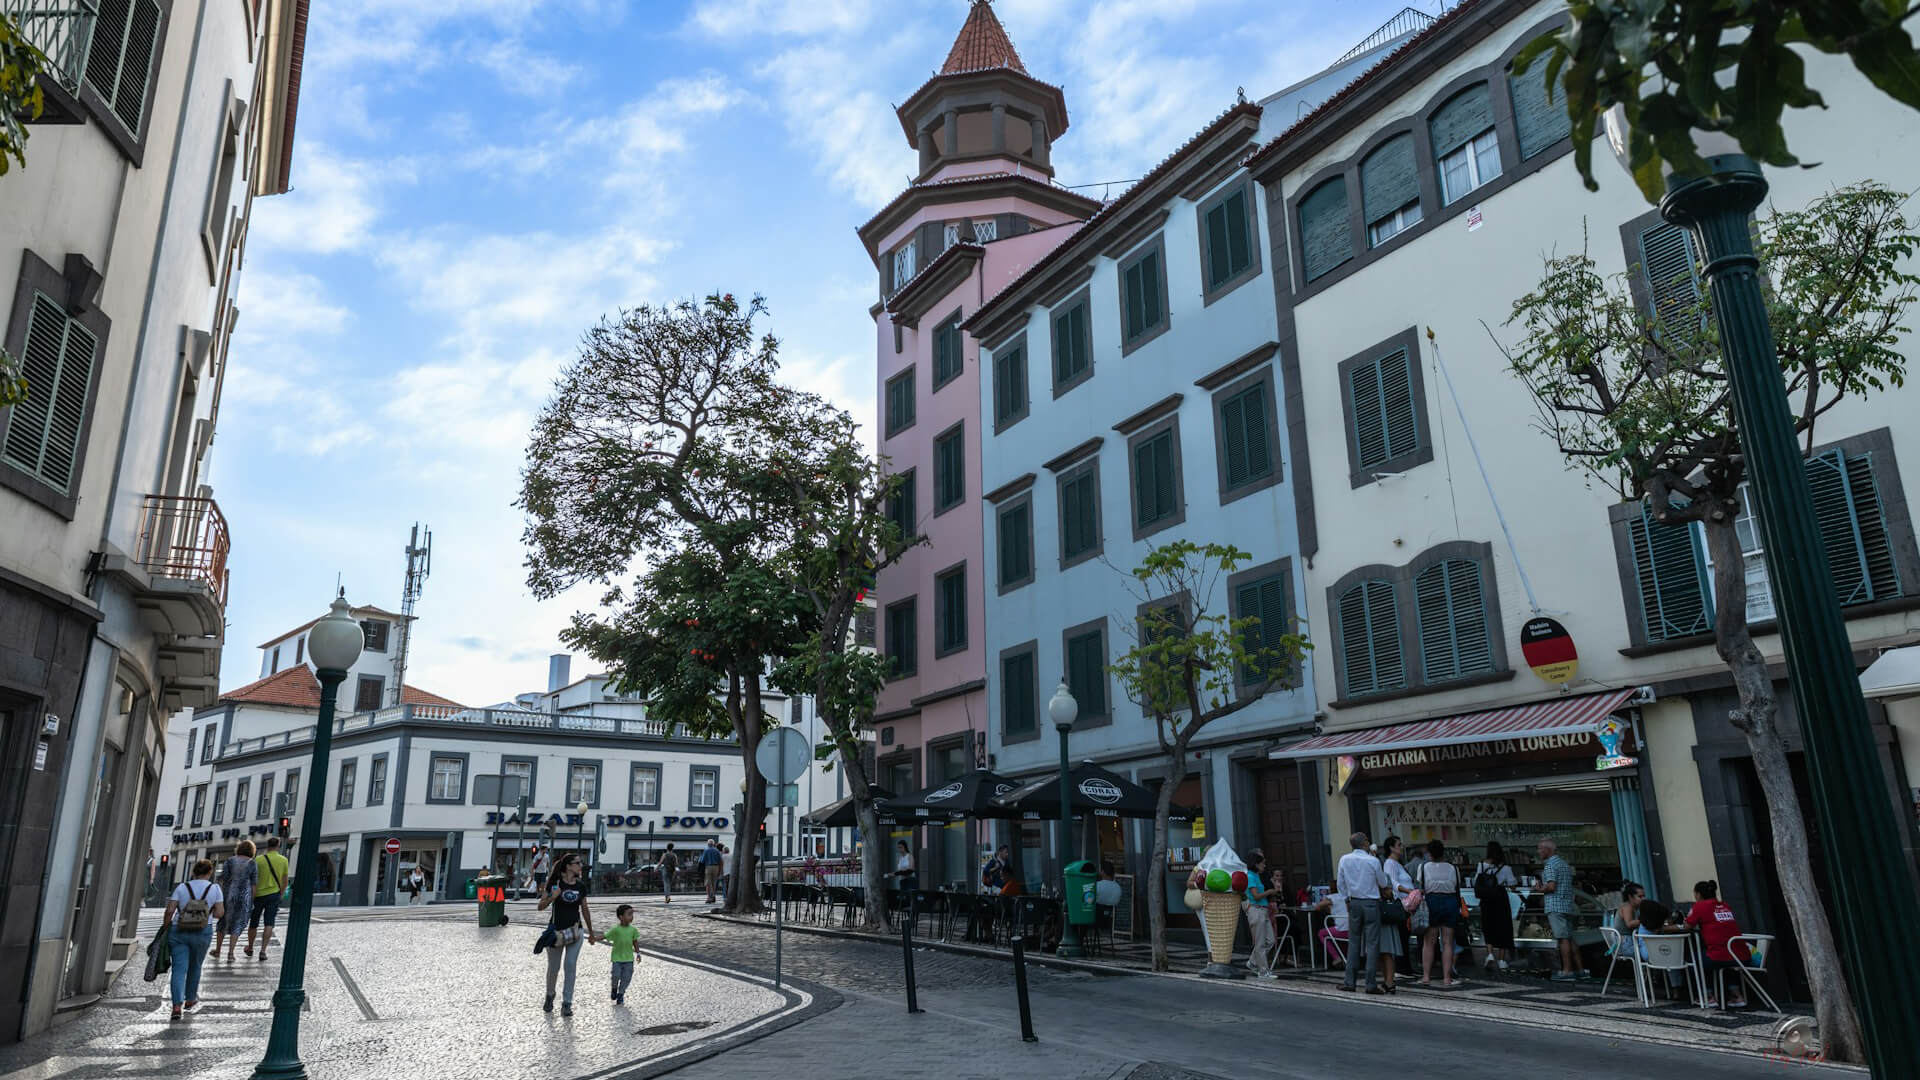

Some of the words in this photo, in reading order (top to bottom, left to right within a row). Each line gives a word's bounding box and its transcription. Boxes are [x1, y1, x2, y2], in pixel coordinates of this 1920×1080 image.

[1361, 749, 1428, 770] GELATARIA
[1429, 742, 1492, 763] ITALIANA
[1495, 740, 1517, 756] DA
[1520, 731, 1591, 753] LORENZO
[1085, 786, 1121, 800] CORAL
[486, 811, 584, 826] BAZAR
[607, 814, 643, 828] DO
[663, 815, 729, 829] POVO
[1094, 808, 1120, 818] CORAL
